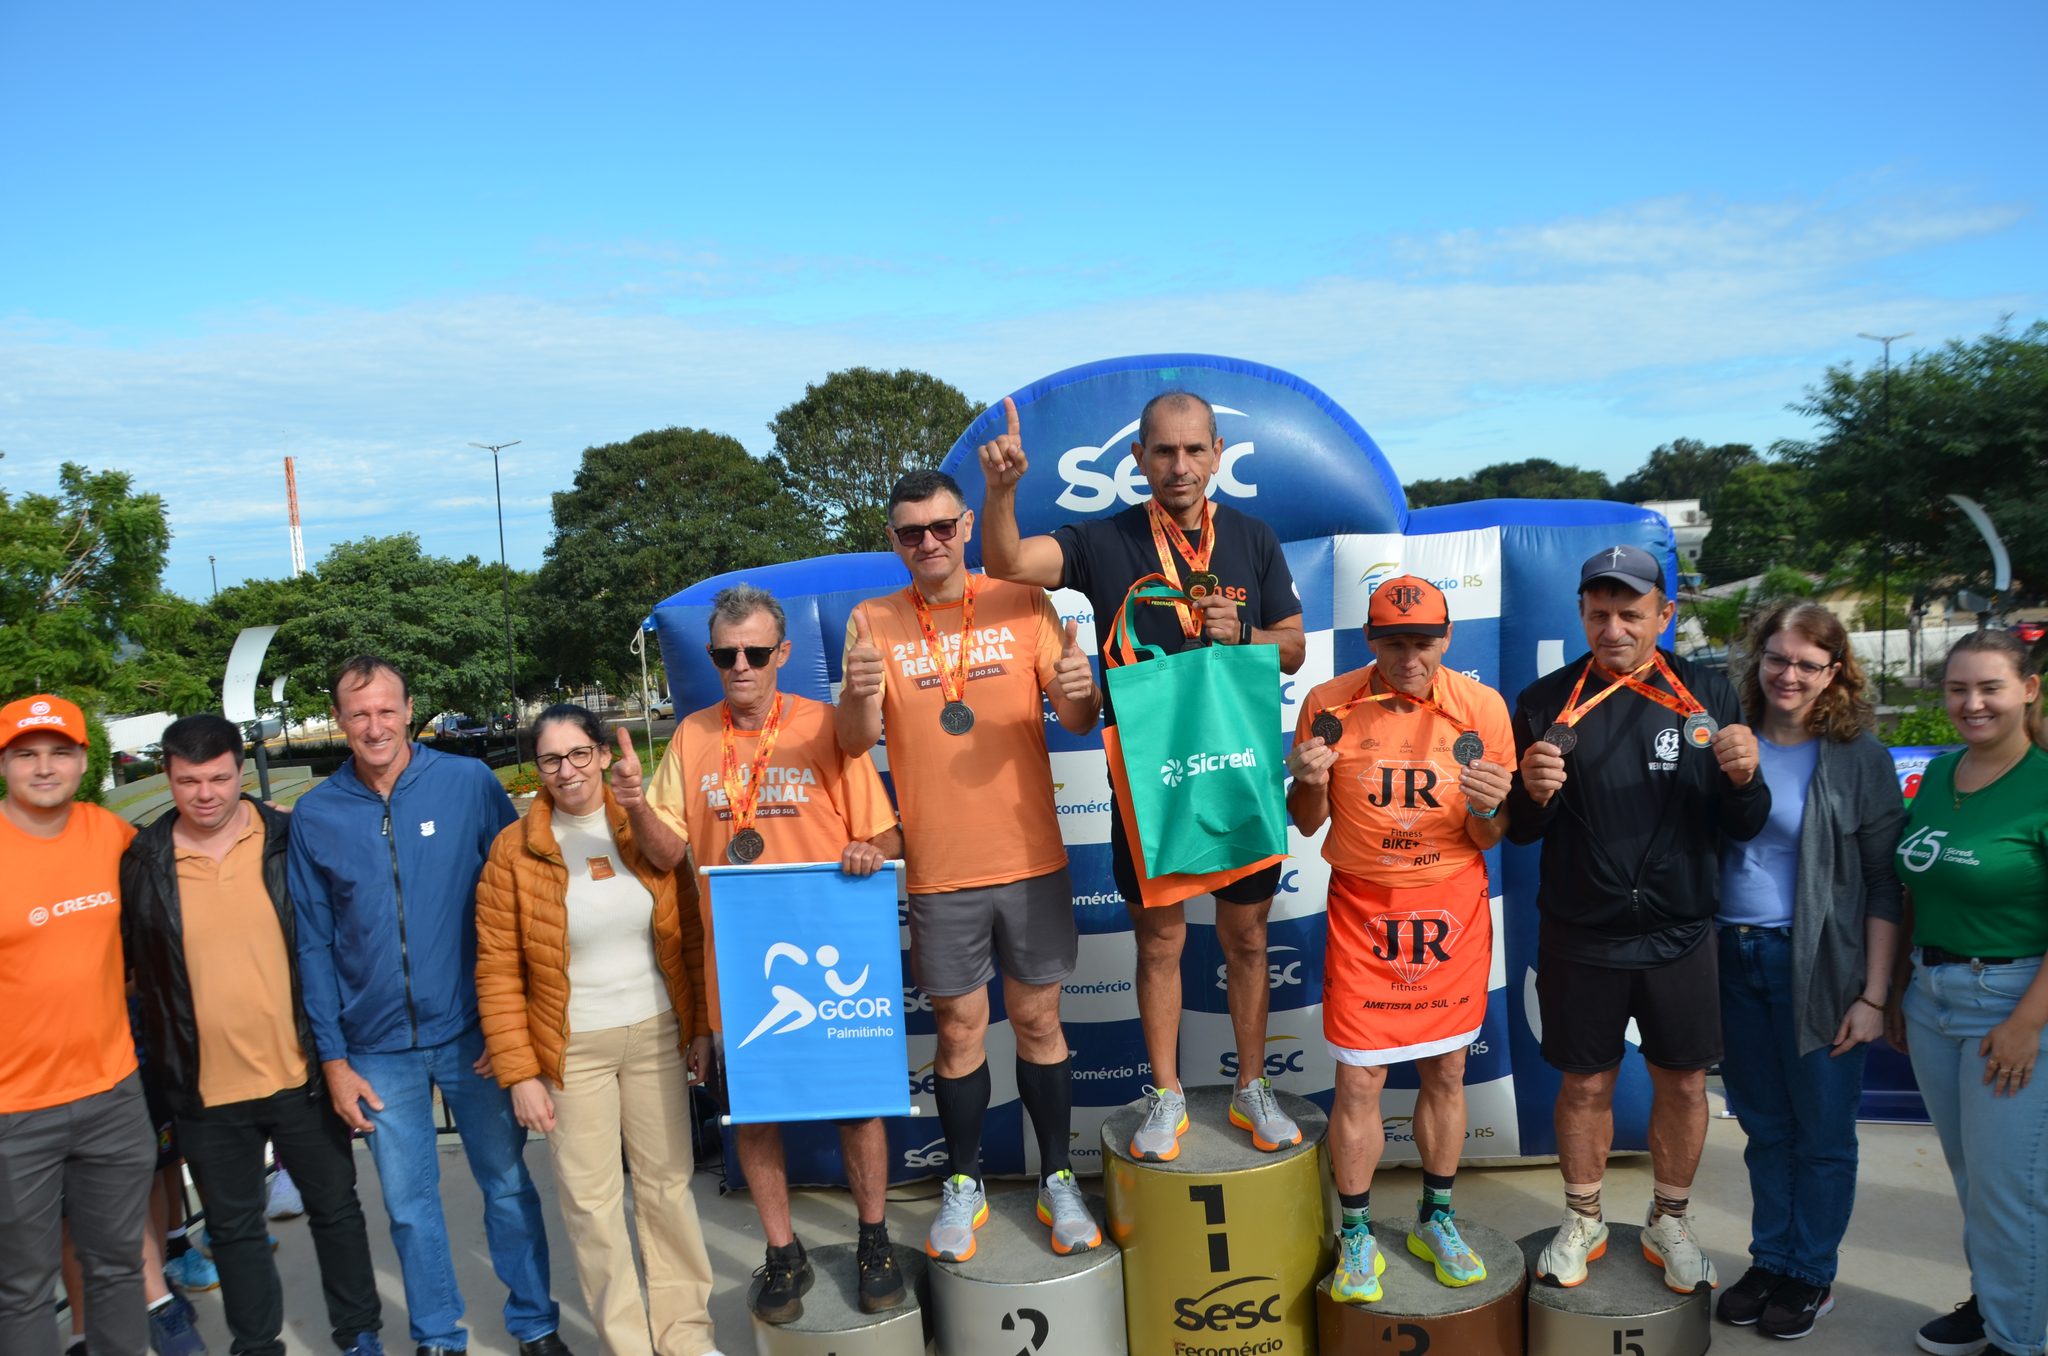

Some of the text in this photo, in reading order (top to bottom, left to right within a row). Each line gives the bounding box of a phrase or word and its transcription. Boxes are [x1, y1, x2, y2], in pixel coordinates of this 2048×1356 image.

[1055, 441, 1258, 512] Sec
[1463, 574, 1483, 588] RS
[1392, 588, 1422, 605] JR
[920, 679, 931, 687] DE
[975, 669, 986, 678] DO
[987, 667, 1001, 675] SUL
[17, 714, 66, 728] CRESOL
[1186, 748, 1257, 777] Sicredi
[701, 772, 718, 791] 2ª
[1367, 766, 1443, 808] JR
[1391, 828, 1422, 839] Fitness
[1896, 826, 1949, 872] 45
[1413, 852, 1441, 866] RUN
[52, 891, 116, 917] CRESOL
[1372, 918, 1452, 965] JR
[1391, 982, 1428, 992] Fitness
[818, 998, 892, 1020] GCOR
[1363, 999, 1412, 1010] AMETISTA
[1414, 1002, 1429, 1010] DO
[1431, 1000, 1449, 1009] SUL
[828, 1026, 894, 1039] Palmitinho
[1469, 1041, 1489, 1055] RS
[1474, 1127, 1495, 1139] RS
[1189, 1184, 1230, 1272] 1
[1174, 1294, 1281, 1331] Sesc
